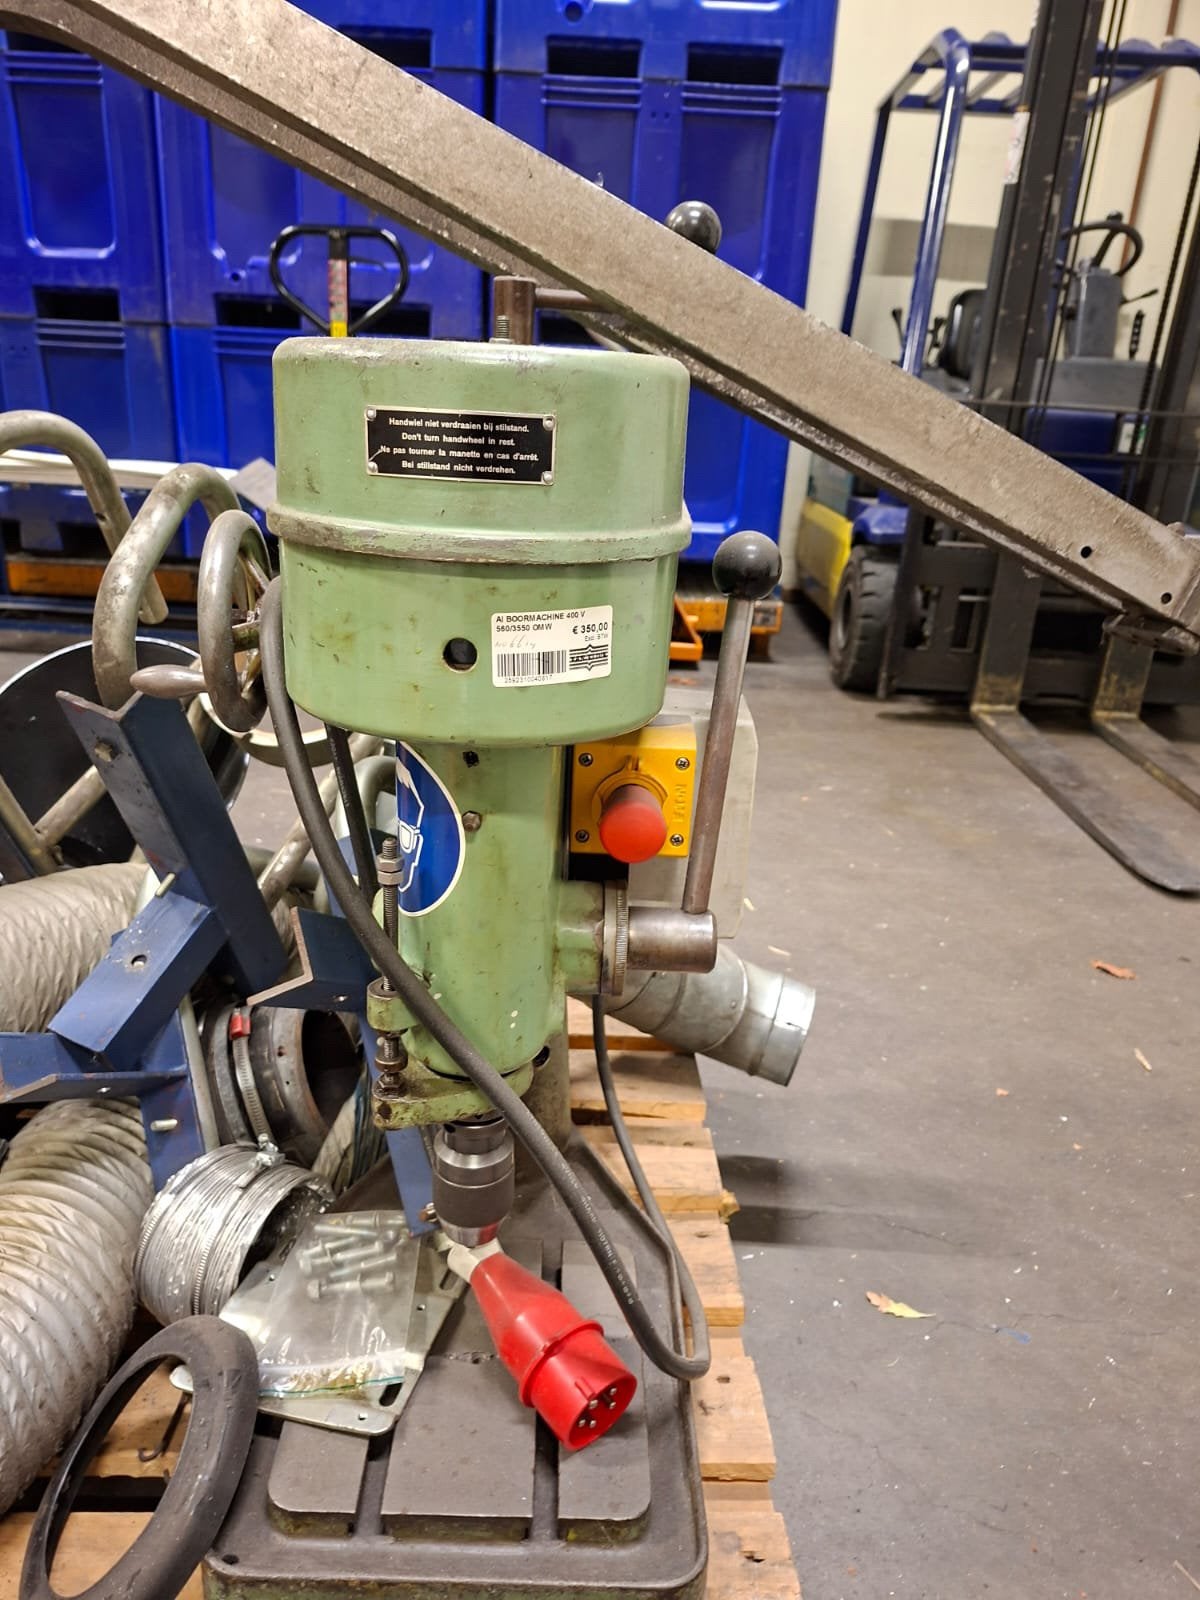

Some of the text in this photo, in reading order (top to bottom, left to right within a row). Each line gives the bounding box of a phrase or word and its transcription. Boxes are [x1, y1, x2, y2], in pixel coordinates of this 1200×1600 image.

[425, 419, 440, 428] niet
[441, 420, 481, 431] verdraaien
[483, 422, 494, 432] bij
[402, 432, 516, 446] Don't turn handwheel in rest.
[380, 445, 391, 453] Ne
[393, 447, 406, 455] pas
[408, 447, 436, 456] tourner
[438, 448, 447, 457] la
[449, 449, 481, 458] manette
[402, 460, 516, 474] Bei stillstand nicht verdrehen.
[506, 612, 565, 623] BOORMACHINE
[566, 611, 579, 619] 400
[580, 610, 586, 618] V
[572, 621, 609, 635] € 350,00
